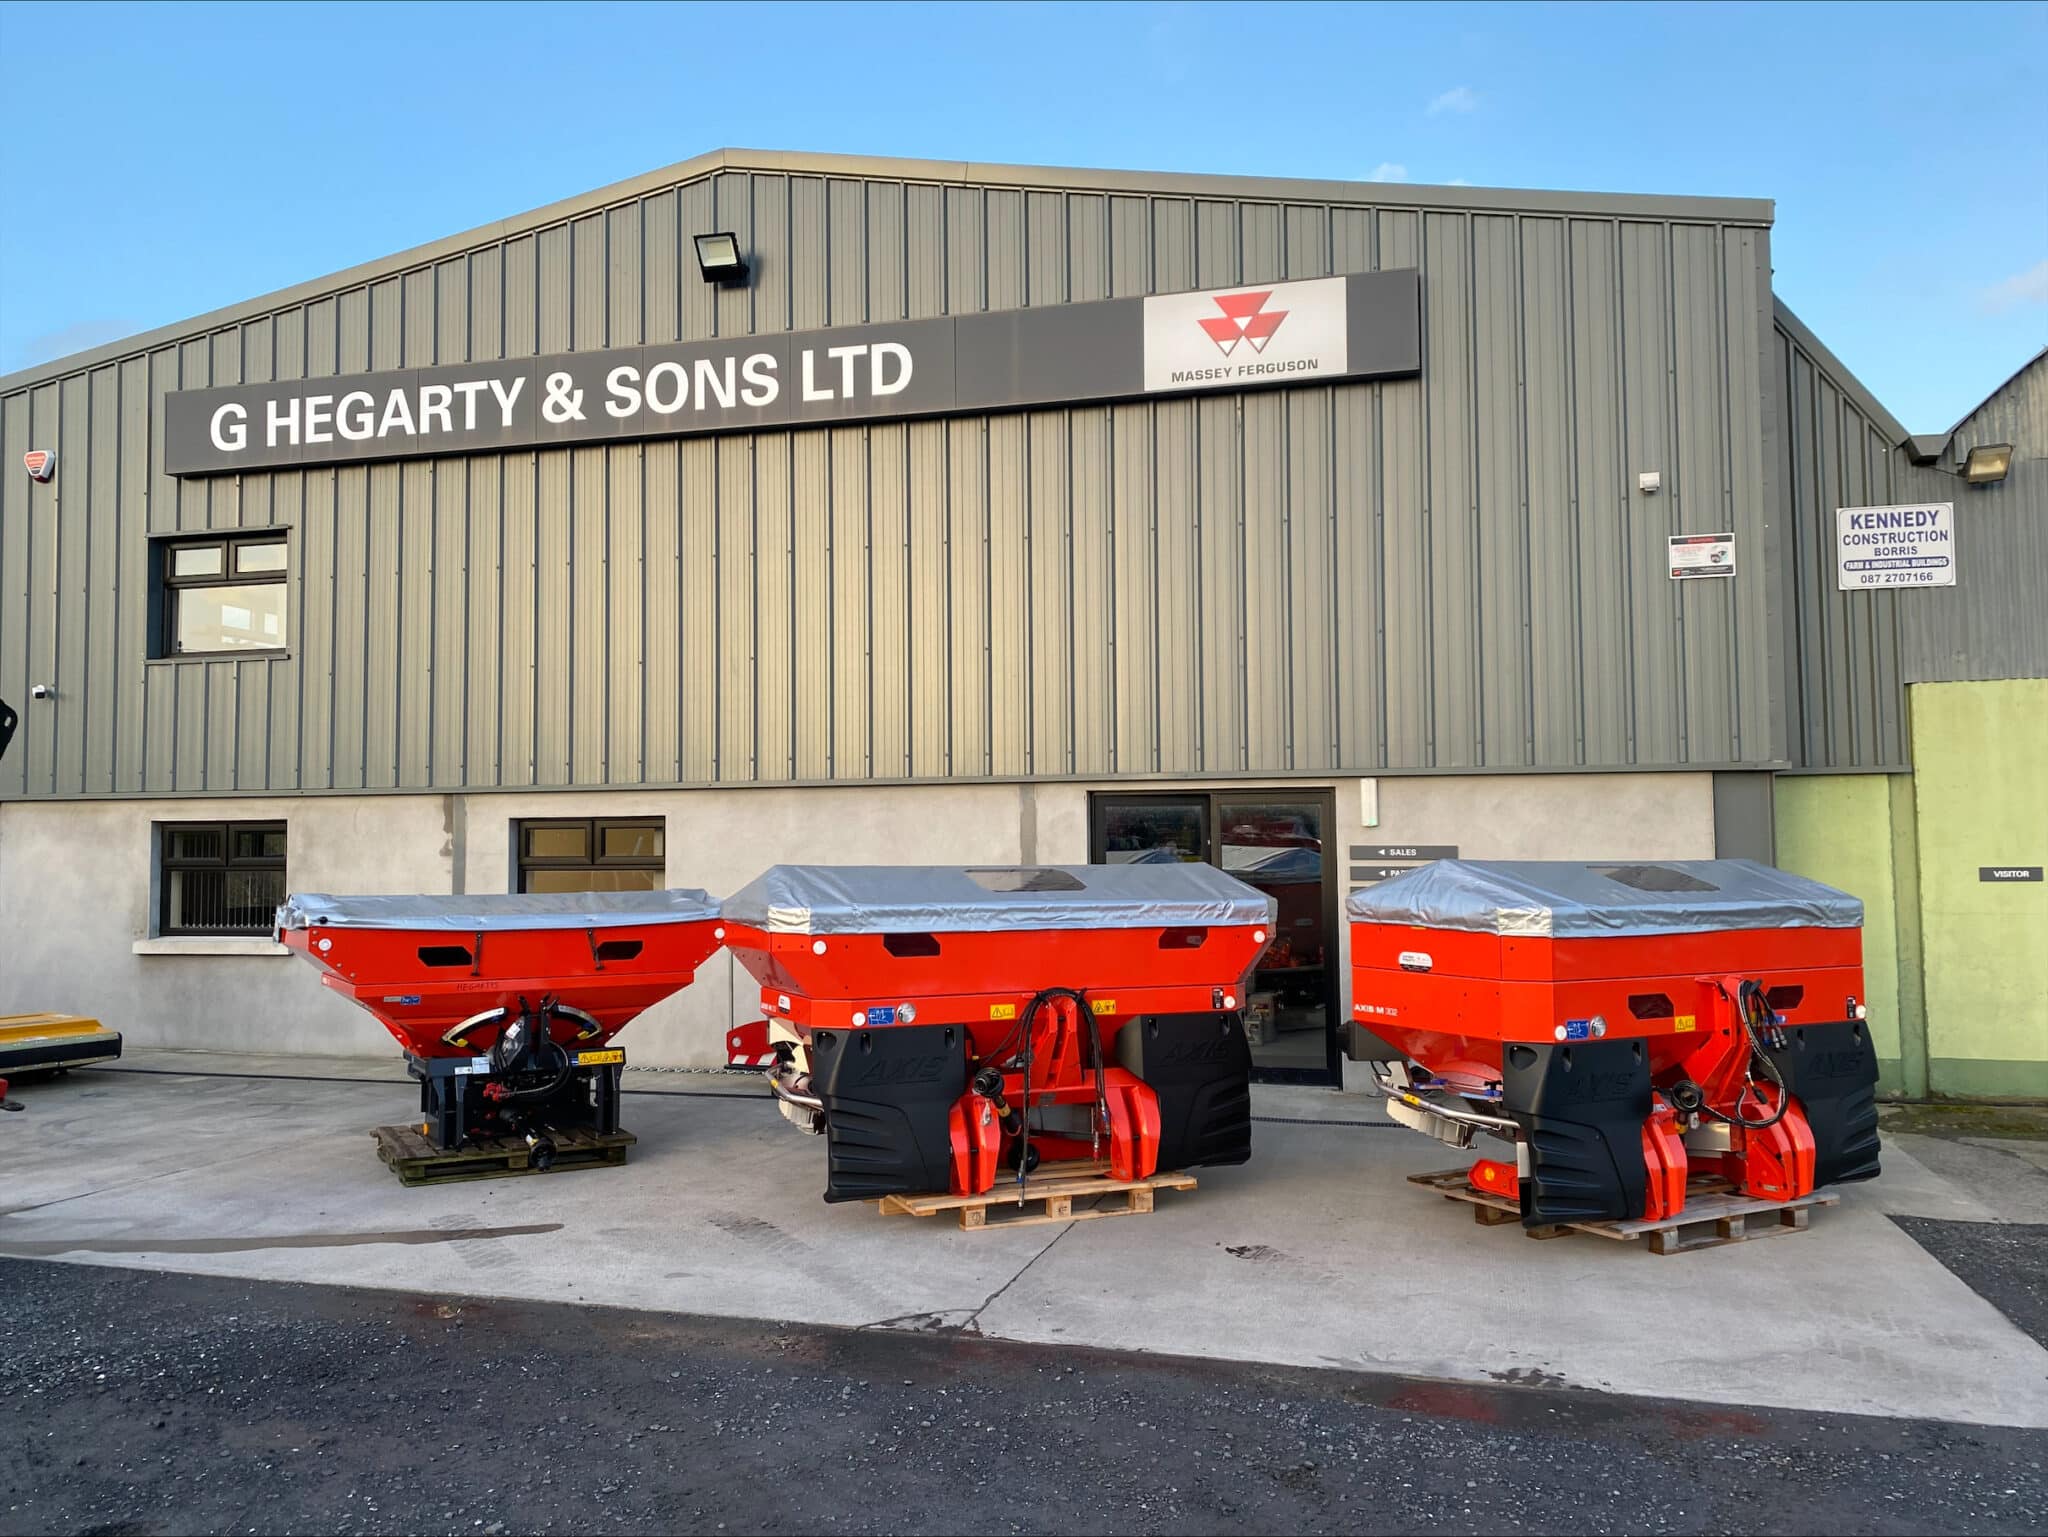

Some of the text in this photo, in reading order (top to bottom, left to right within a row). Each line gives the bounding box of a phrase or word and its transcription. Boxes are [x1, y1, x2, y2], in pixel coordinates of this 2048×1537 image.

[1171, 358, 1319, 383] MASSEY FERGUSON
[210, 342, 913, 451] G HEGARTY & SONS LTD
[1850, 510, 1939, 530] KENNEDY
[1843, 530, 1948, 546] CONSTRUCTION
[1874, 546, 1918, 556] BORRIS
[1872, 559, 1911, 569] INDUSTRIAL
[1860, 572, 1934, 584] 087 2707166
[1390, 848, 1416, 856] SALES
[1992, 870, 2030, 878] VISITOR
[1354, 1003, 1374, 1013] AXIS
[861, 1055, 948, 1082] AXIS
